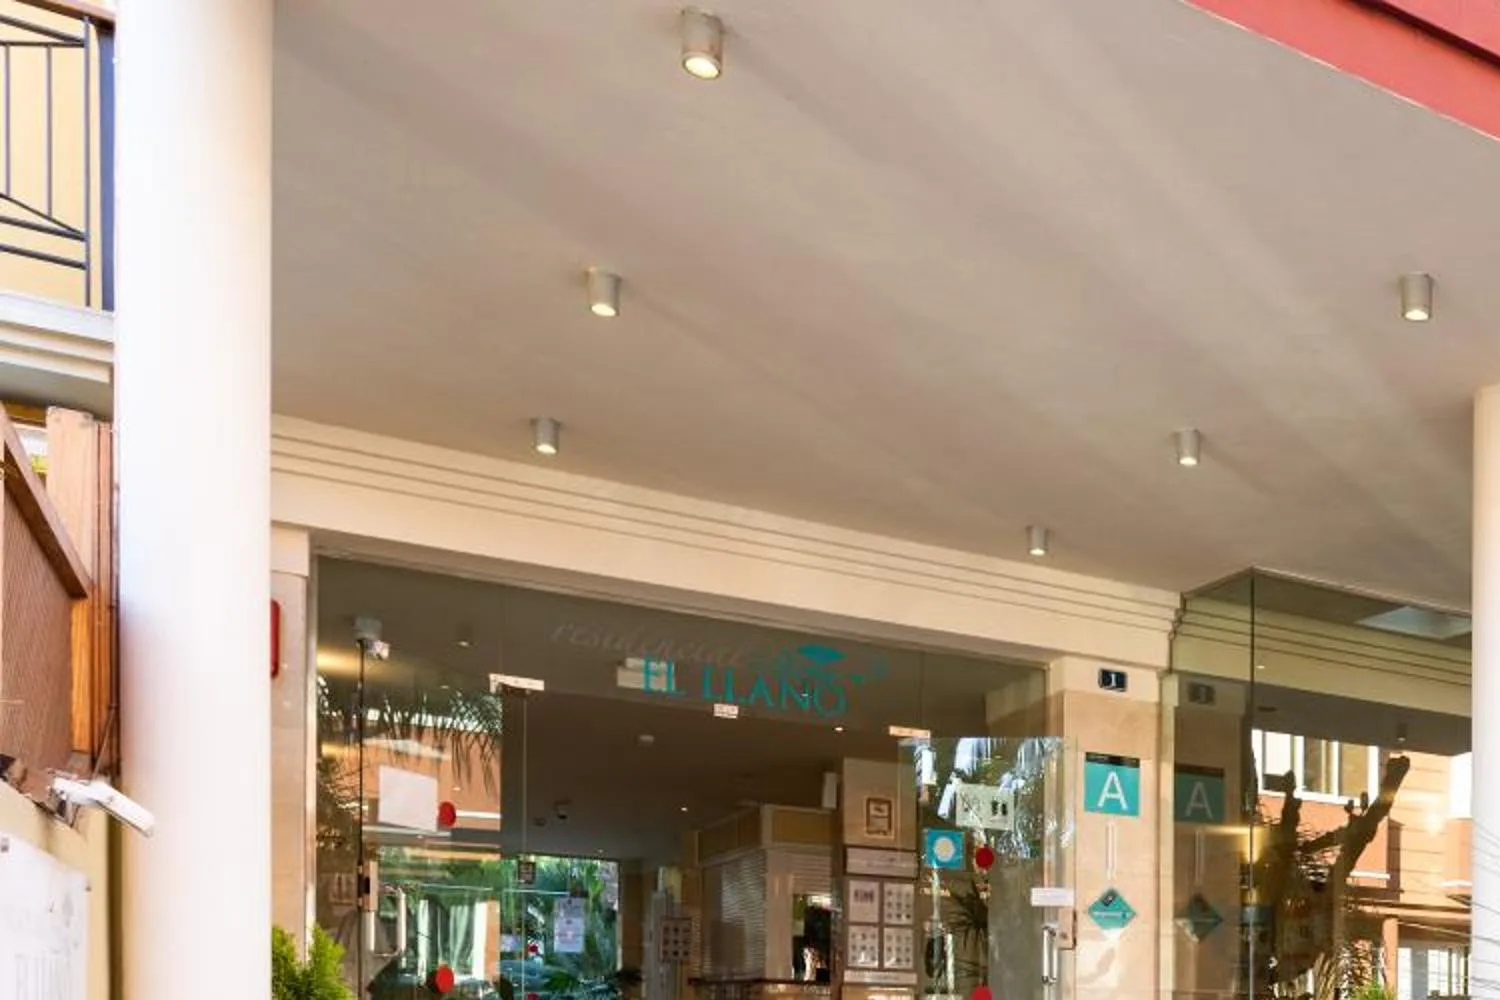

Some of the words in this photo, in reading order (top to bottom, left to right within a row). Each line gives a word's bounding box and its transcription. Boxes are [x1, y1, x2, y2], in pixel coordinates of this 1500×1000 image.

[643, 655, 685, 696] EL
[702, 663, 848, 718] LLANO
[1096, 770, 1129, 812] A
